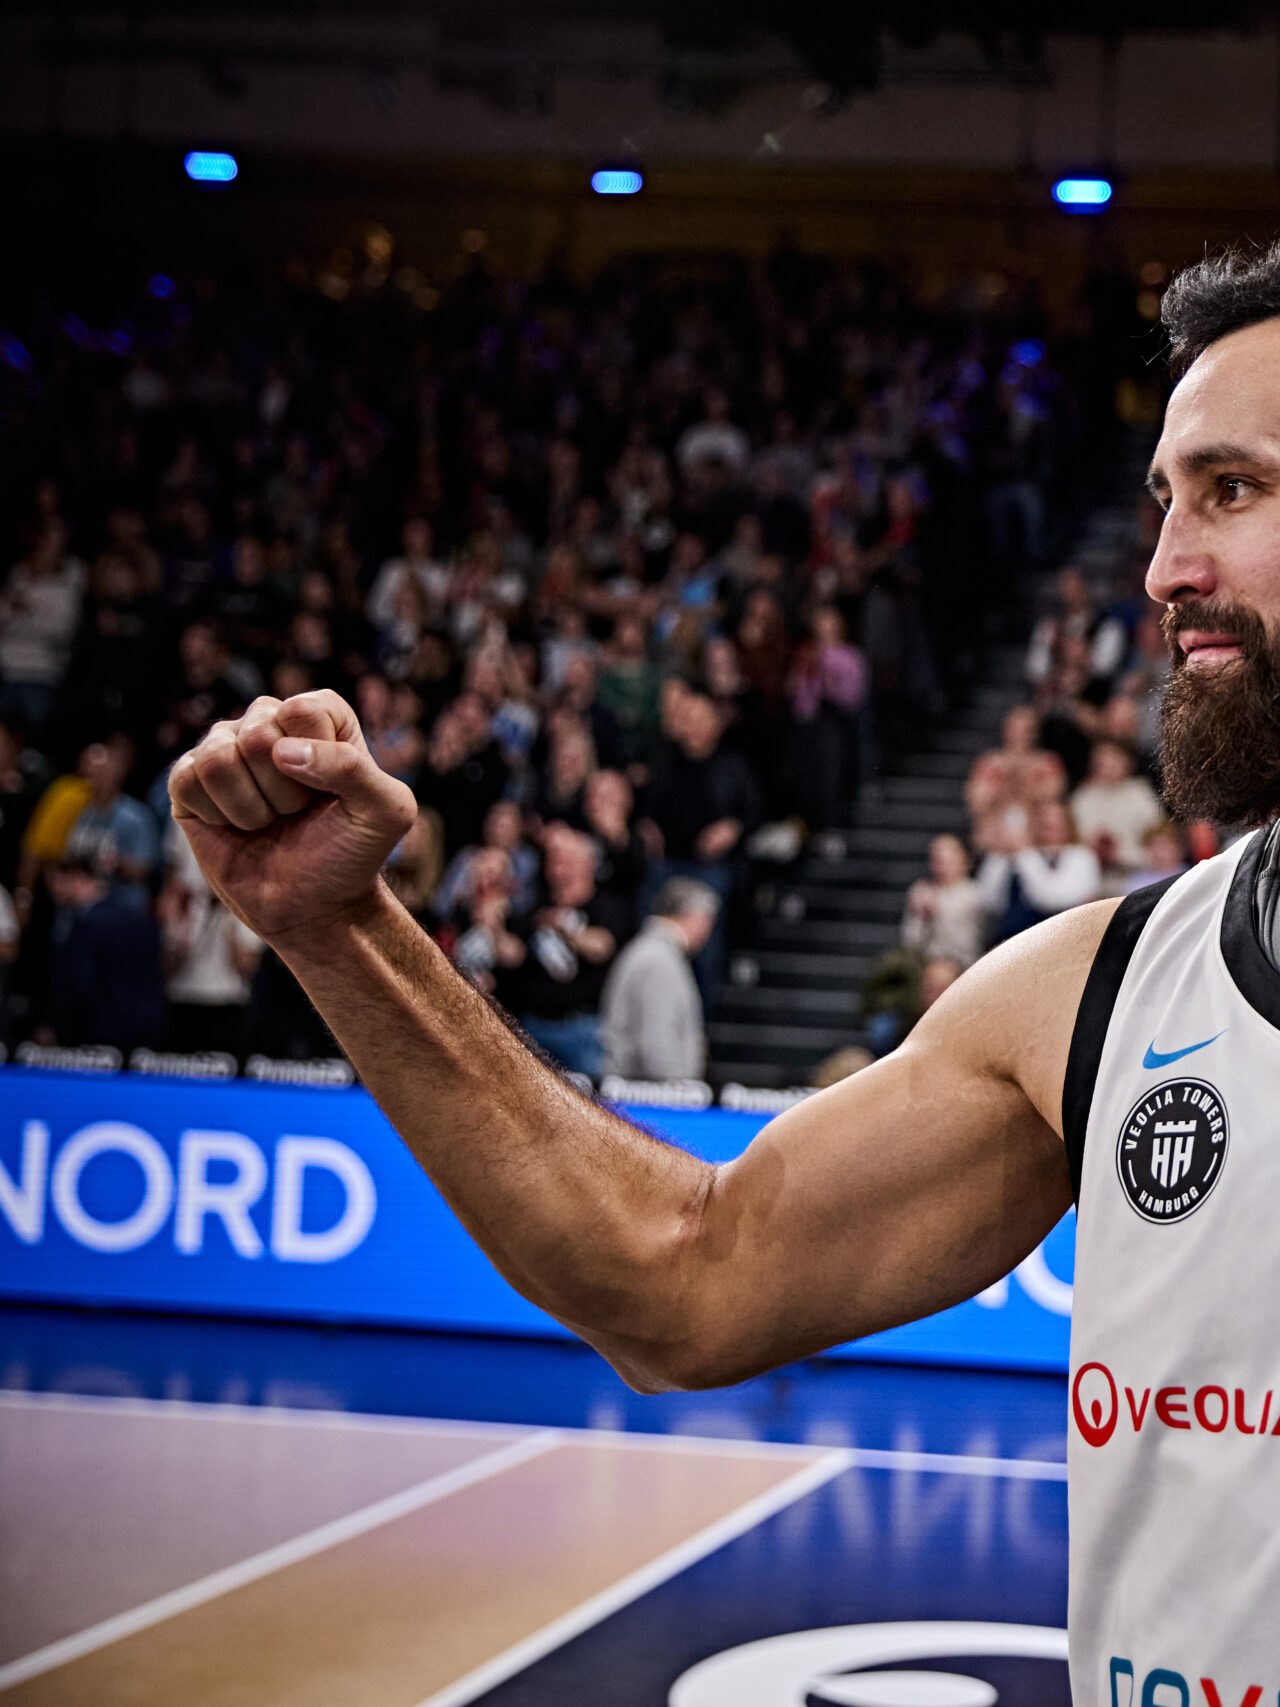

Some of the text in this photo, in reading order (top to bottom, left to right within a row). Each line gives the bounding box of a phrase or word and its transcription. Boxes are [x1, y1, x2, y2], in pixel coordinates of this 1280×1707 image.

[1125, 1087, 1223, 1149] VEOLIA TOWERS
[1138, 1186, 1199, 1213] HAMBURG
